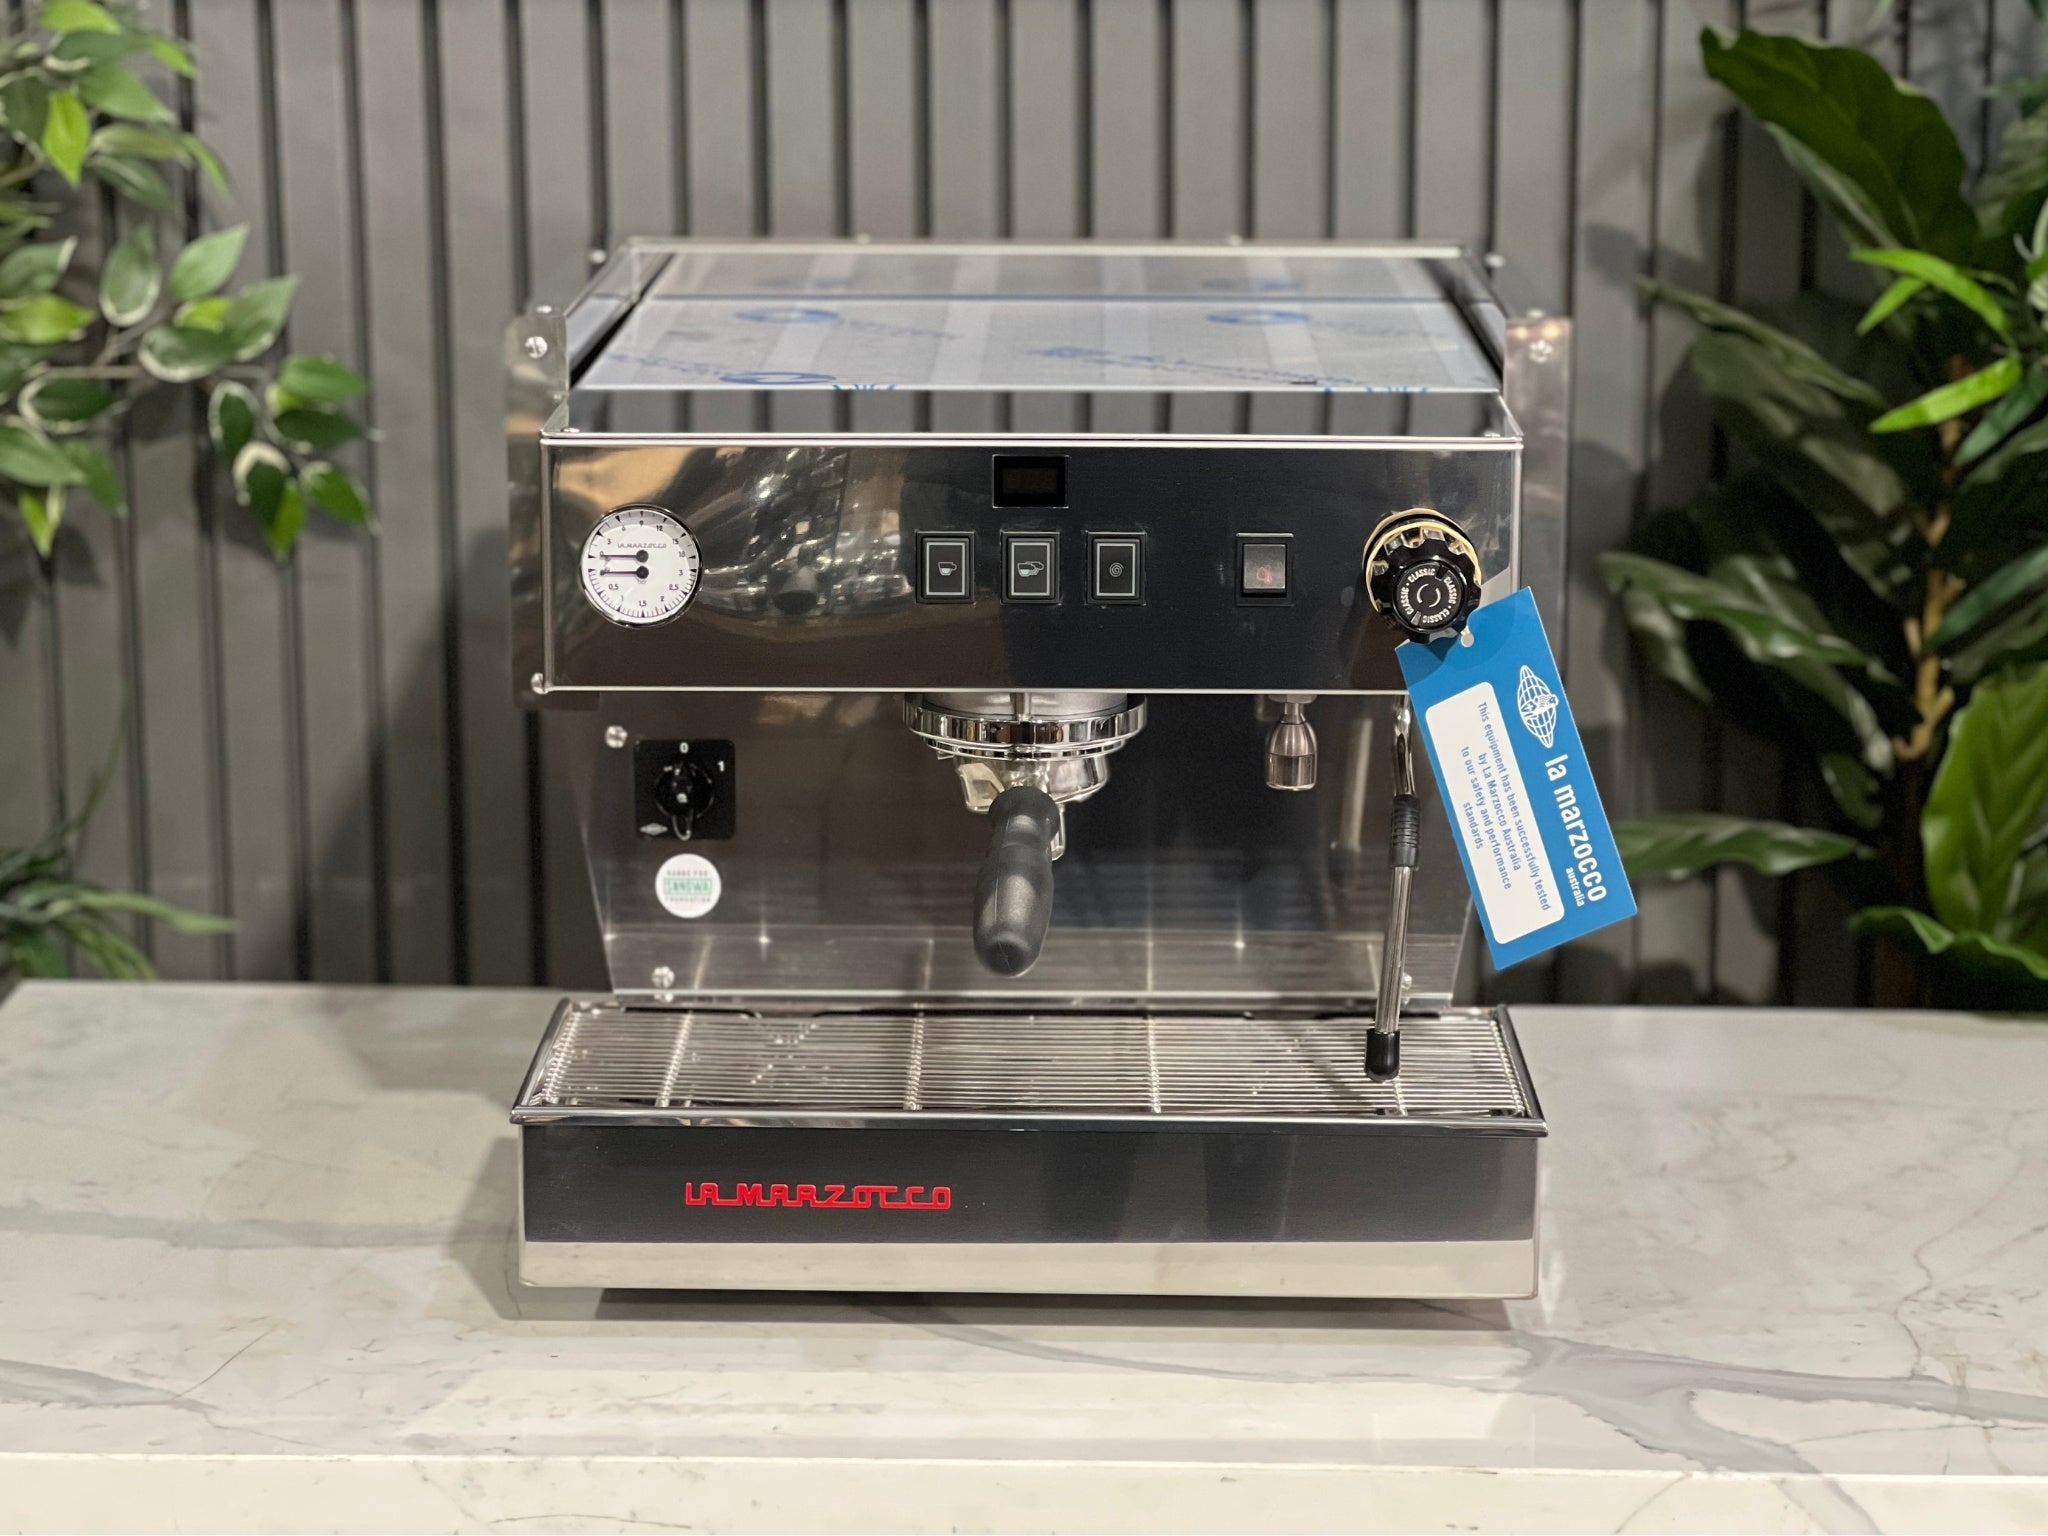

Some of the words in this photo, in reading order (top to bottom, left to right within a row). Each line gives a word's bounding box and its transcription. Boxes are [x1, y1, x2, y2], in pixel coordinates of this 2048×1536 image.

[1400, 587, 1414, 615] CLASSIC
[1408, 568, 1436, 583] CLASSIC
[1443, 576, 1458, 605] CLASSIC
[1422, 608, 1450, 623] CLASSIC
[717, 760, 725, 772] 1
[1461, 746, 1470, 758] to
[1478, 752, 1488, 765] by
[1464, 759, 1476, 775] our
[1482, 766, 1492, 779] La
[1544, 754, 1569, 782] la
[1470, 777, 1486, 807] safety
[1477, 701, 1489, 723] This
[1484, 723, 1507, 774] equipment
[1500, 774, 1512, 793] has
[1506, 792, 1520, 818] been
[1514, 819, 1540, 878] successfully
[1534, 879, 1552, 911] tested
[1486, 779, 1507, 827] Marzocco
[1463, 802, 1484, 849] standards
[1480, 808, 1494, 827] and
[1502, 828, 1521, 871] Australia
[1553, 784, 1607, 902] marzocco
[1484, 827, 1512, 890] performance
[1565, 867, 1585, 907] australia
[686, 1182, 718, 1206] LA
[736, 1183, 951, 1209] MARZOCCO
